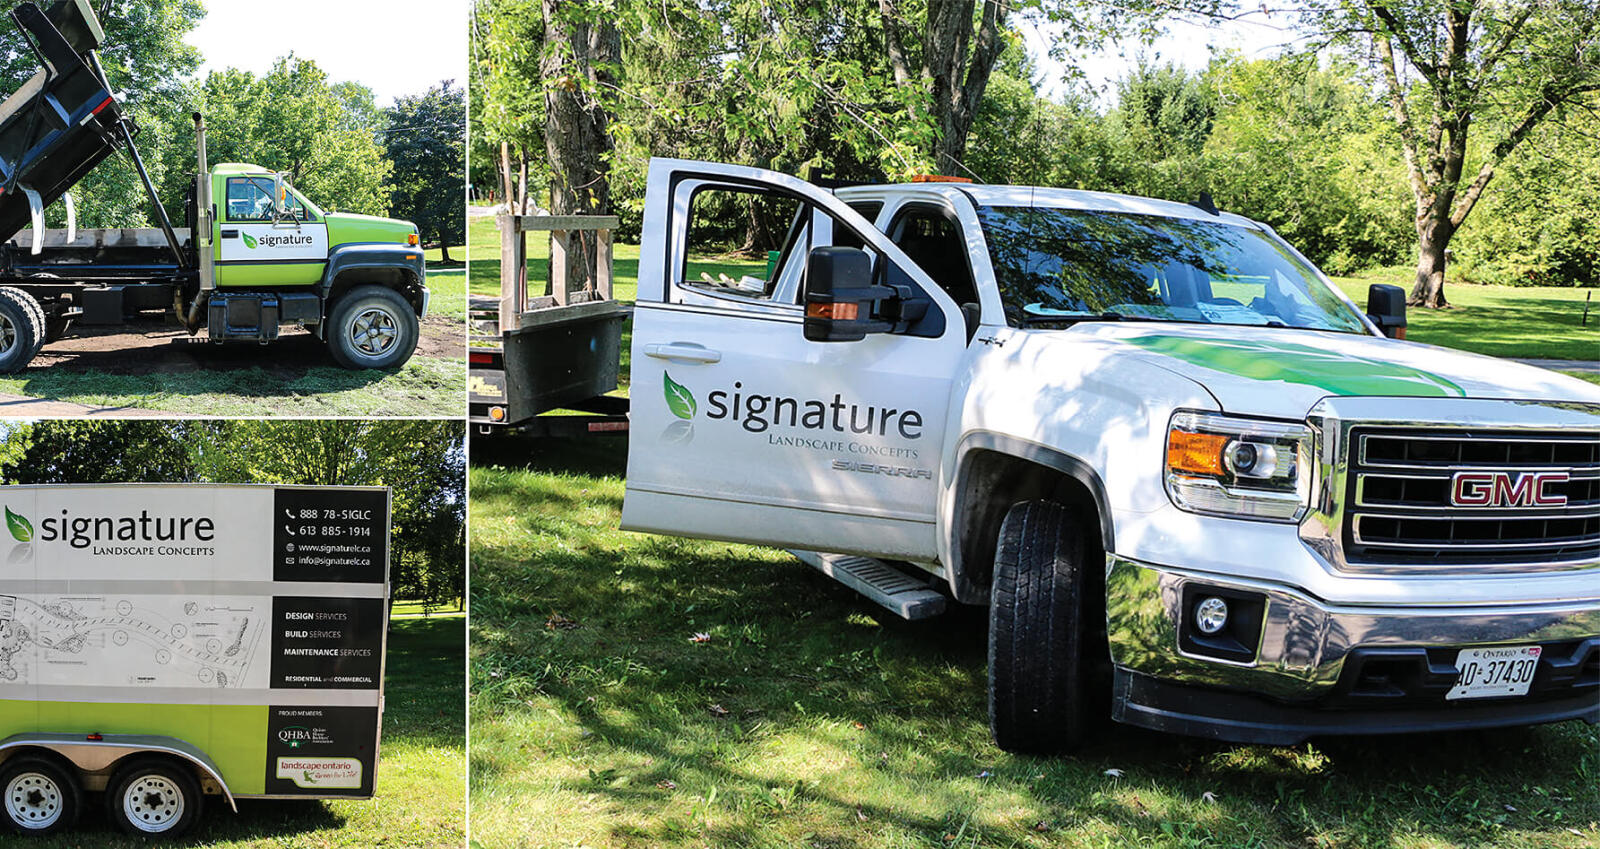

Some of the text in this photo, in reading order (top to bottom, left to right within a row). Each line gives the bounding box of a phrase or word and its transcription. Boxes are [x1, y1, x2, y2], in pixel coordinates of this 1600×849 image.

[260, 234, 312, 247] signature
[706, 381, 923, 440] signature
[832, 458, 932, 480] SIERRA
[1451, 472, 1569, 506] GMC
[300, 509, 318, 519] 888
[41, 509, 215, 548] signature
[299, 526, 316, 536] 613
[298, 544, 371, 553] www.signaturelc.ca
[298, 556, 371, 566] info@signaturelc.ca
[285, 612, 347, 620] DESIGN SERVICES
[285, 630, 341, 638] BUILD SERVICES
[284, 648, 371, 657] MAINTENANCE SERVICES
[278, 730, 311, 742] QHBA
[281, 762, 351, 770] landscape ontario
